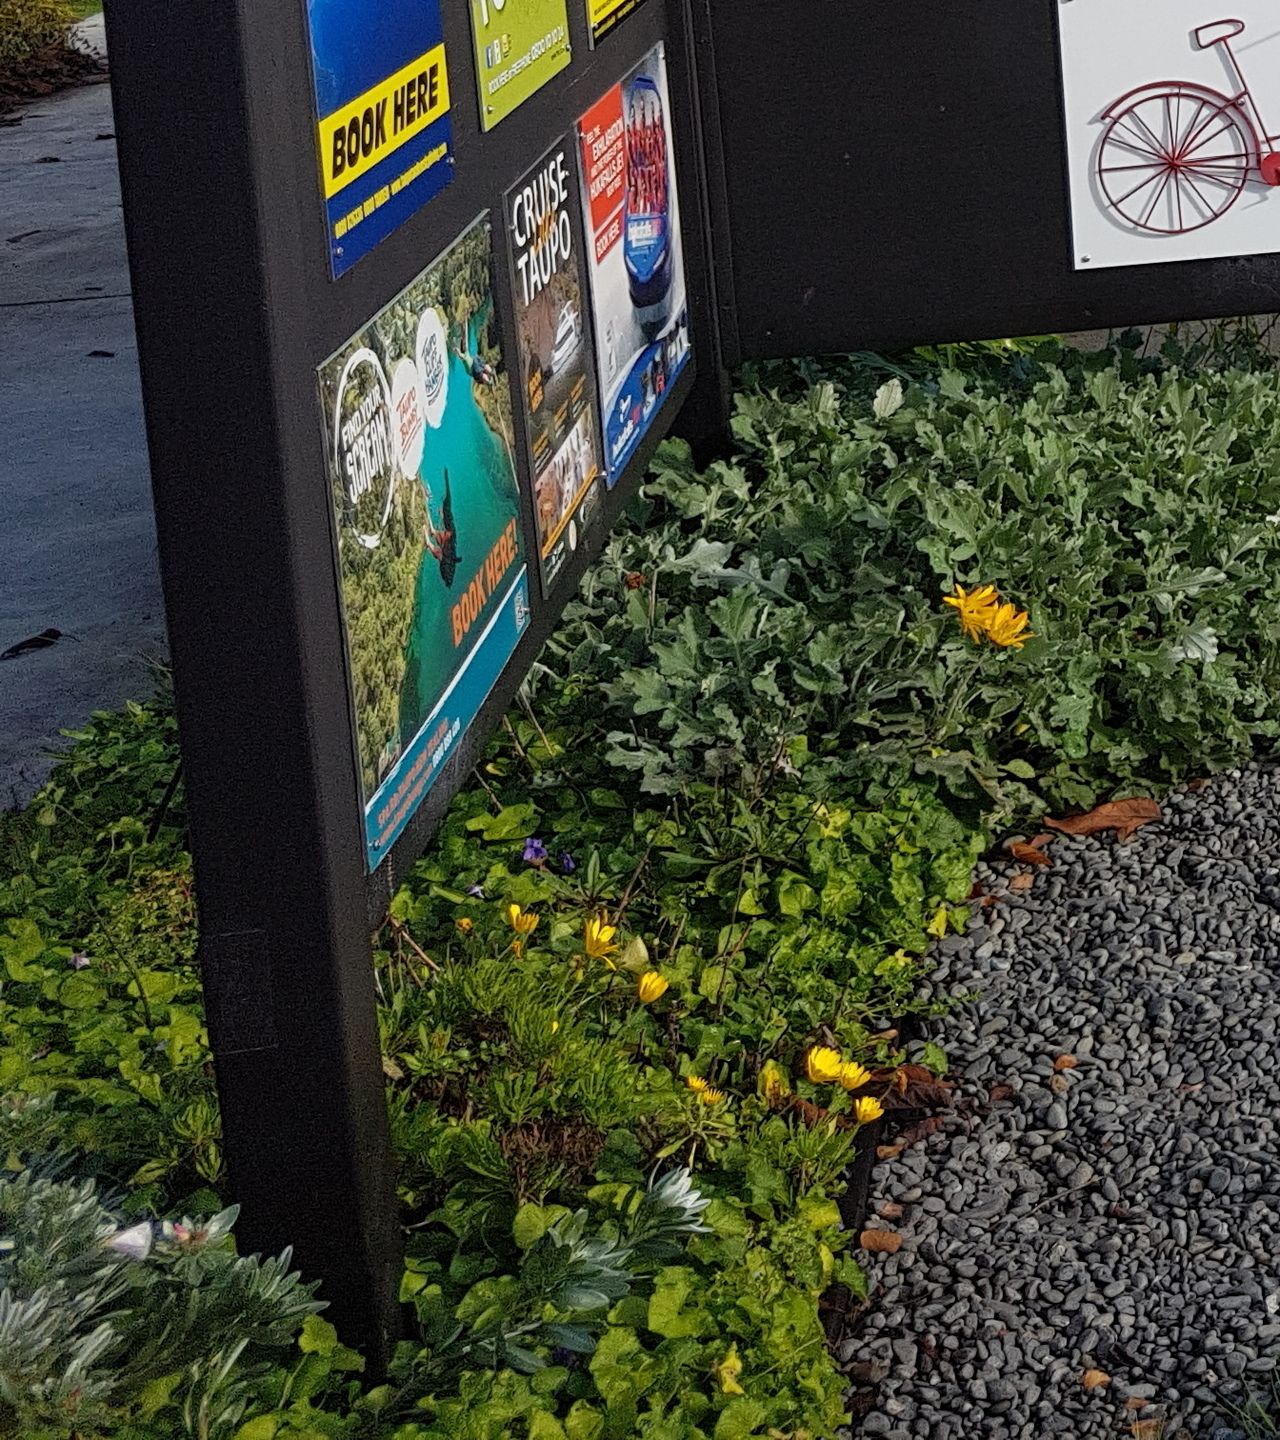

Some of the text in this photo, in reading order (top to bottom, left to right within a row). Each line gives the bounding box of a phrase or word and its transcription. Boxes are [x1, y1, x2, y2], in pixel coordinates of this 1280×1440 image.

[332, 96, 388, 180] BOOK
[393, 62, 438, 137] HERE
[513, 152, 568, 247] CRUISE
[518, 210, 570, 307] TAUPO
[342, 384, 383, 451] FIND YOUR
[346, 409, 391, 504] SCREAM
[451, 517, 519, 648] BOOK HERE!
